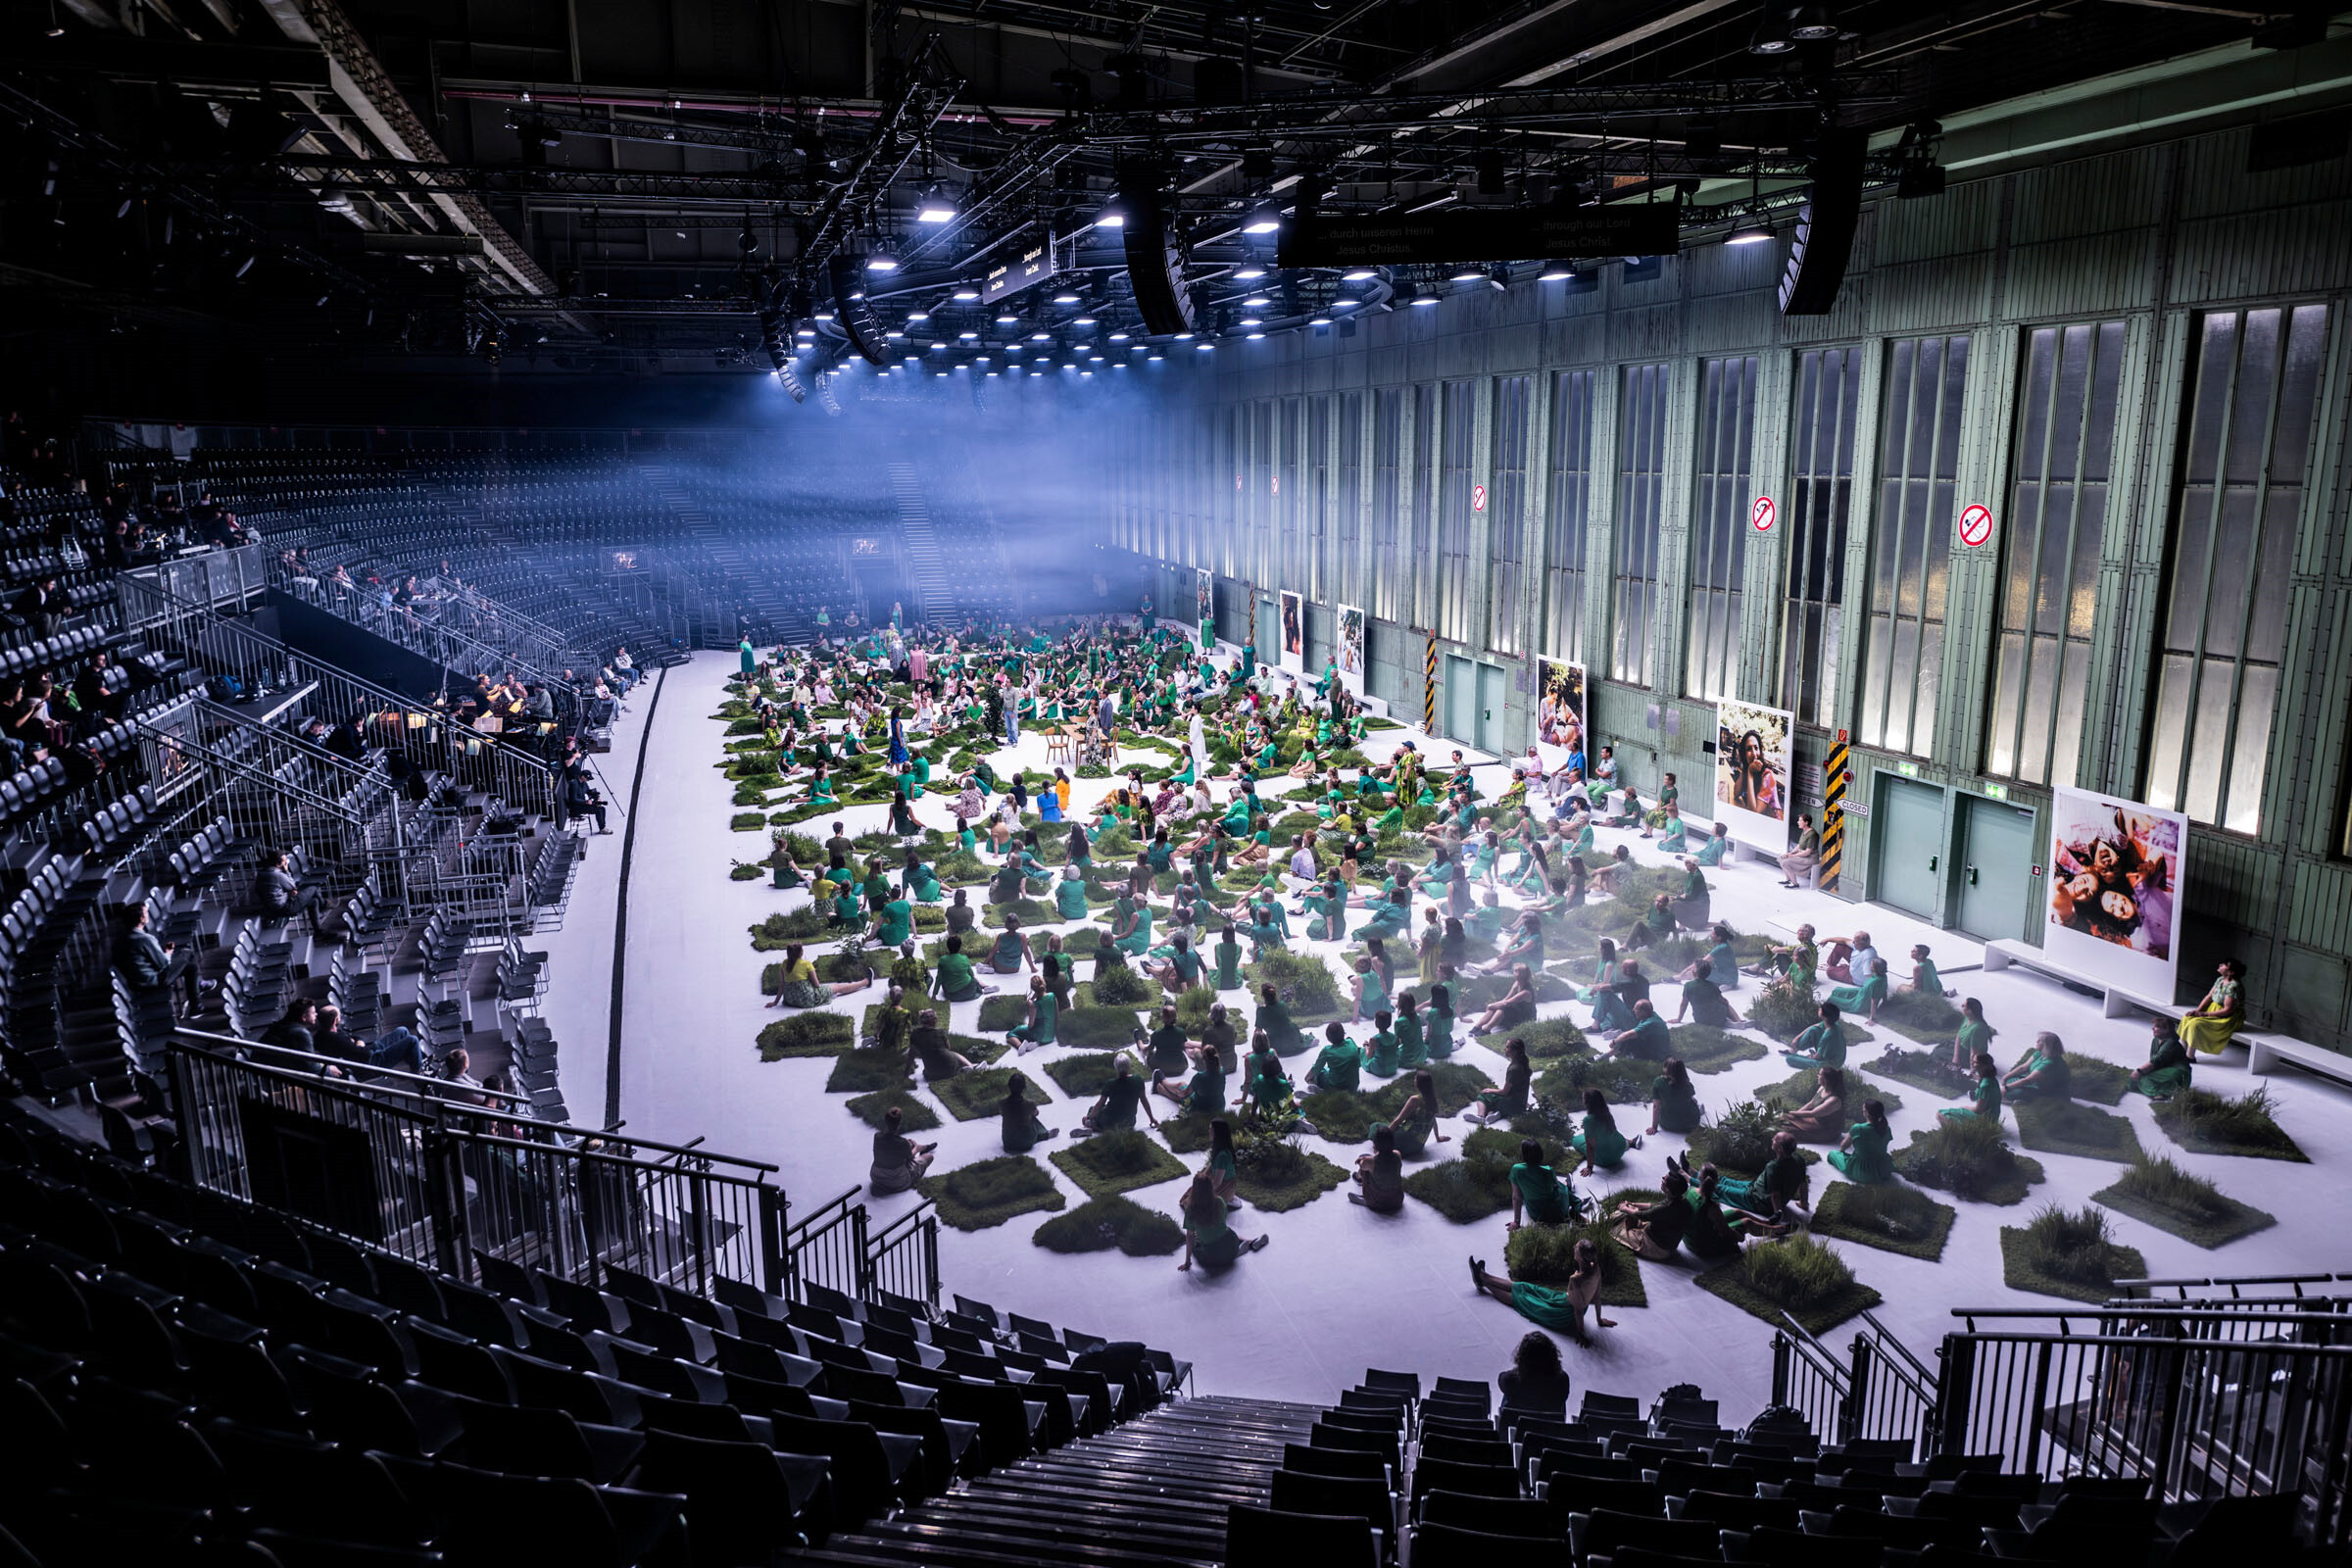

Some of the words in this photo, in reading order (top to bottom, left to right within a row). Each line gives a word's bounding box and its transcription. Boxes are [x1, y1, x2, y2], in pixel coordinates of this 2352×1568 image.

[1607, 217, 1631, 227] Lord
[1361, 228, 1401, 237] unseren
[1404, 225, 1434, 235] Herrn
[1545, 237, 1576, 248] Jesus
[1336, 244, 1365, 255] Jesus
[1797, 795, 1816, 806] OPEN
[1842, 802, 1867, 813] CLOSED
